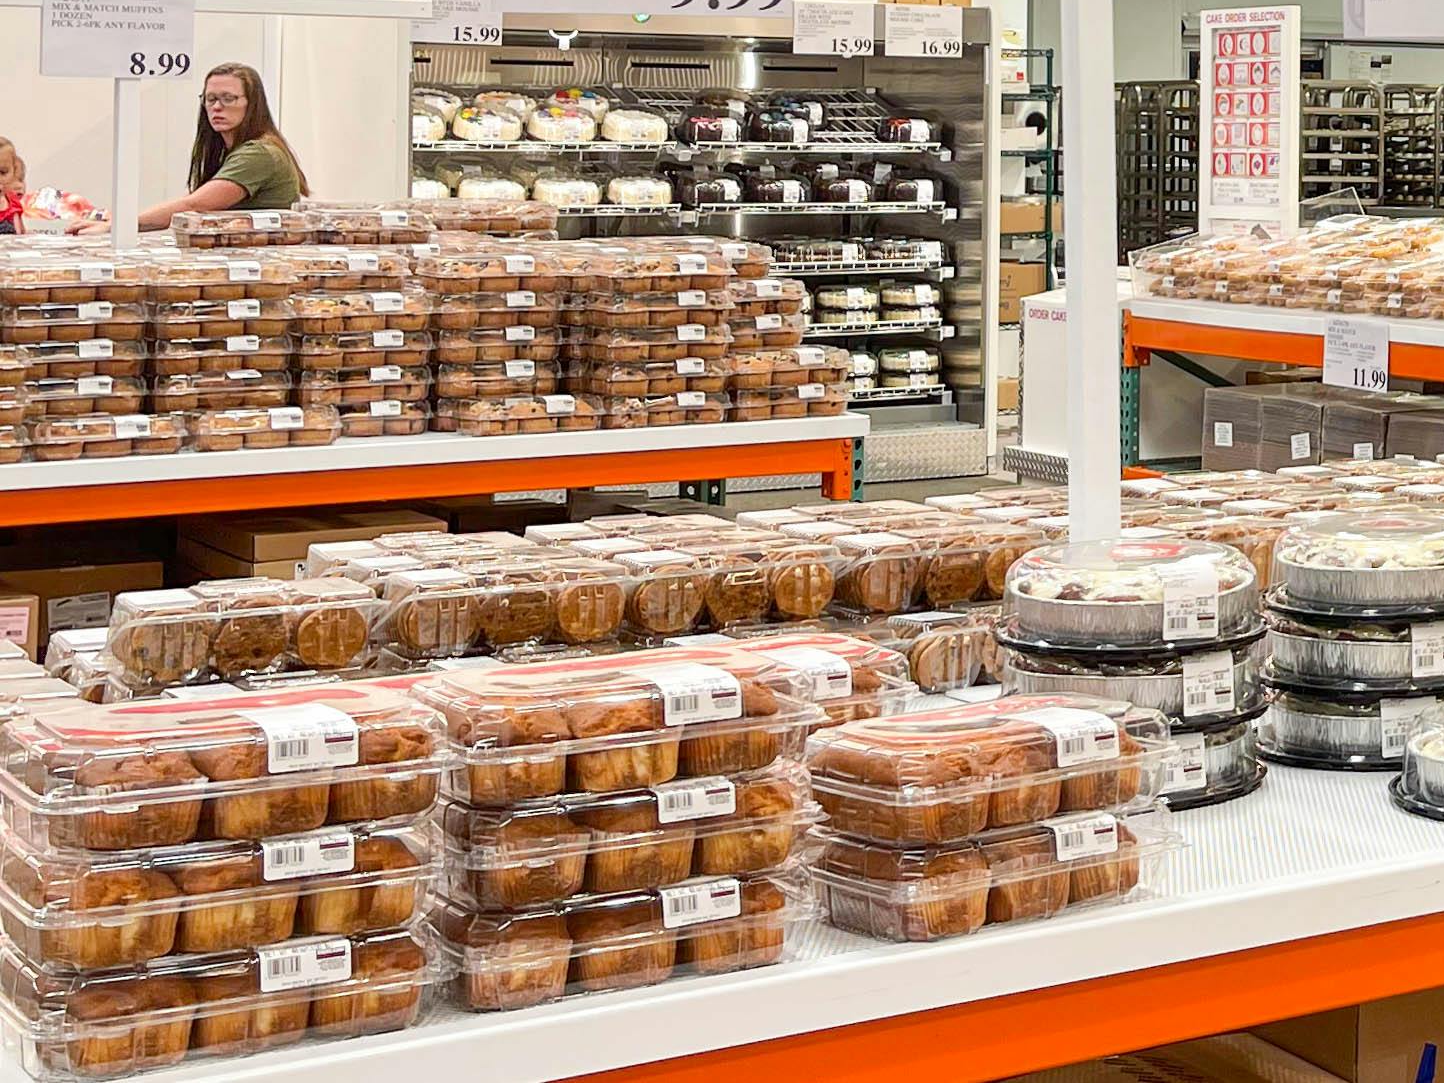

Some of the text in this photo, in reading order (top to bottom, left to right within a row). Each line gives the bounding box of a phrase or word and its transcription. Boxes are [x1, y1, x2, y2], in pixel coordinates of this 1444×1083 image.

[52, 3, 72, 11] MIX
[84, 4, 119, 13] MATCH
[122, 5, 164, 14] MUFFINS
[51, 20, 73, 28] PICK
[104, 21, 125, 29] ANY
[128, 21, 165, 30] FLAVOR
[1206, 11, 1285, 24] CAKE ORDER SELECTION
[453, 26, 500, 42] 15.99
[831, 38, 872, 53] 15.99
[922, 40, 960, 55] 16.99
[129, 52, 191, 76] 8.99
[1029, 308, 1049, 319] ORDER
[1353, 368, 1386, 389] 11.99
